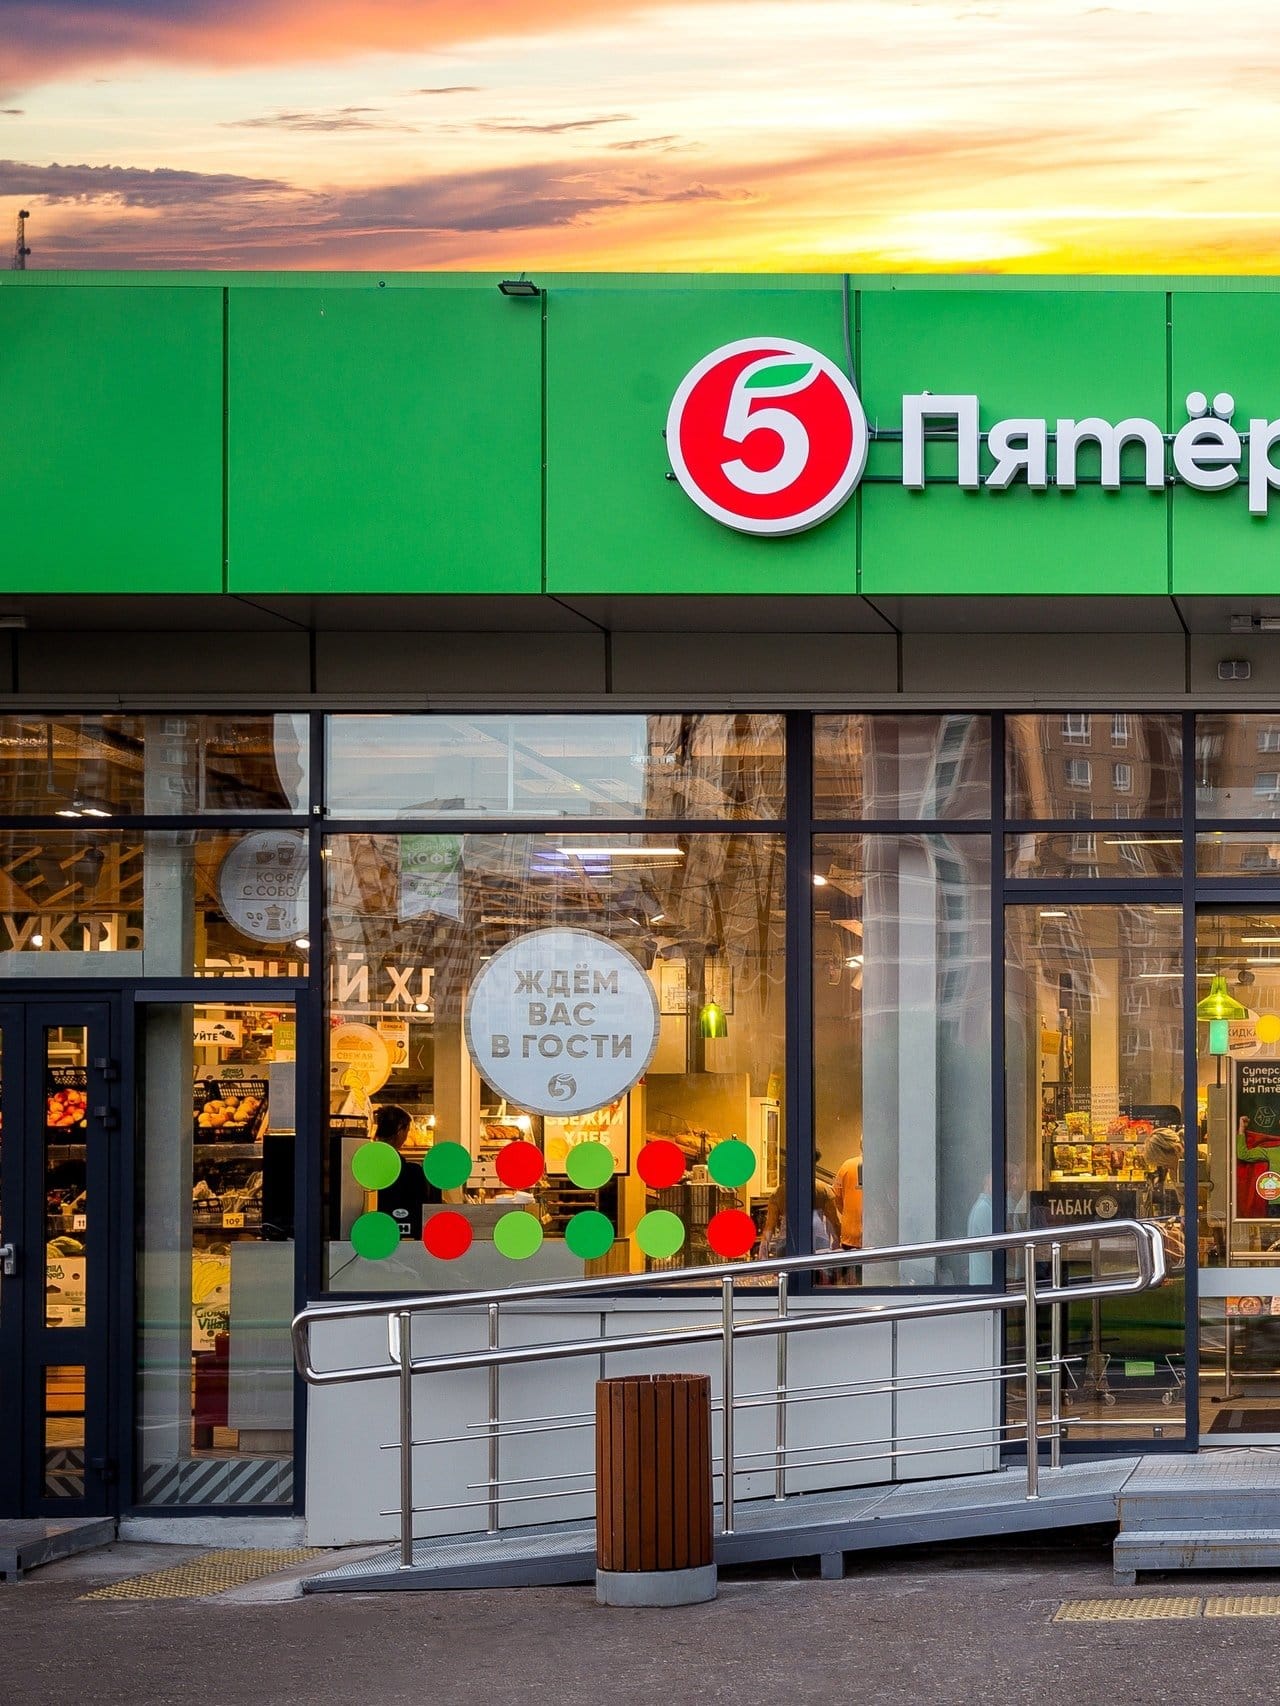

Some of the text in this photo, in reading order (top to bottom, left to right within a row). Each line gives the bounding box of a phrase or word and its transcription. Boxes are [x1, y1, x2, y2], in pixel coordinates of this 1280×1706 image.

[407, 852, 453, 864] КОФЕ
[256, 885, 303, 897] СОБО
[513, 963, 619, 998] ЖДЁМ
[528, 1001, 597, 1027] ВАС
[491, 1033, 633, 1059] В ГОСТИ
[1242, 1086, 1256, 1094] на
[1048, 1199, 1093, 1216] ТАБАК
